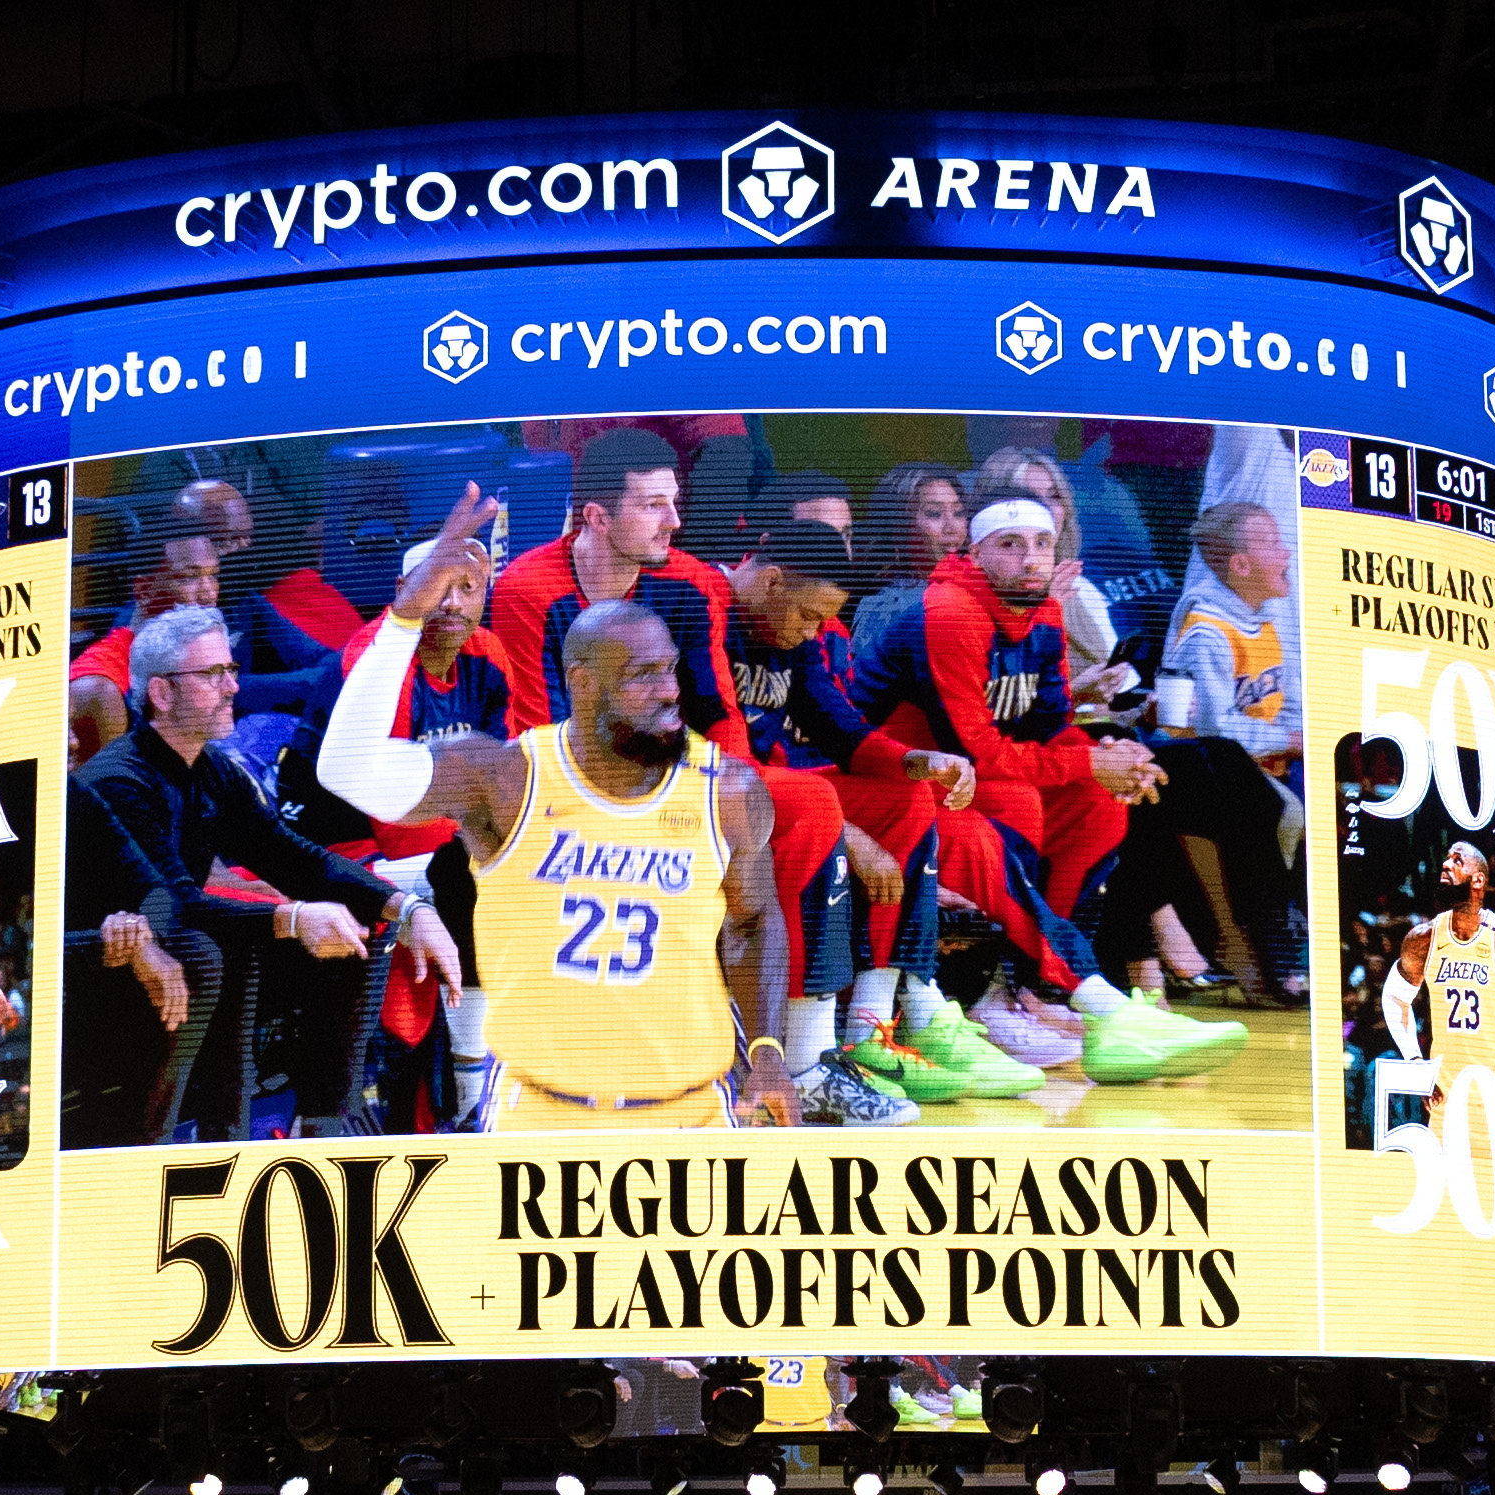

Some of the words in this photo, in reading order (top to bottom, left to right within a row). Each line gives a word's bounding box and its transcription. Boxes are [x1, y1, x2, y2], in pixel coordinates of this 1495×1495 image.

[174, 155, 680, 250] crypto.com
[870, 156, 1157, 219] ARENA
[508, 307, 888, 368] crypto.com
[20, 478, 51, 528] 13
[1365, 451, 1397, 500] 13
[1436, 459, 1487, 502] 6:01
[1432, 499, 1452, 523] 19
[1340, 546, 1477, 605] REGULAR
[1350, 593, 1490, 651] PLAYOFFS
[528, 828, 695, 896] LAKERS
[554, 893, 664, 984] 23
[1433, 955, 1490, 987] LAKERS
[1445, 987, 1482, 1034] 23
[496, 1156, 886, 1241] REGULAR
[902, 1155, 1214, 1238] SEASON
[149, 1151, 457, 1357] 50K
[515, 1246, 929, 1332] PLAYOFFS
[946, 1245, 1242, 1331] POINTS
[765, 1358, 804, 1388] 23
